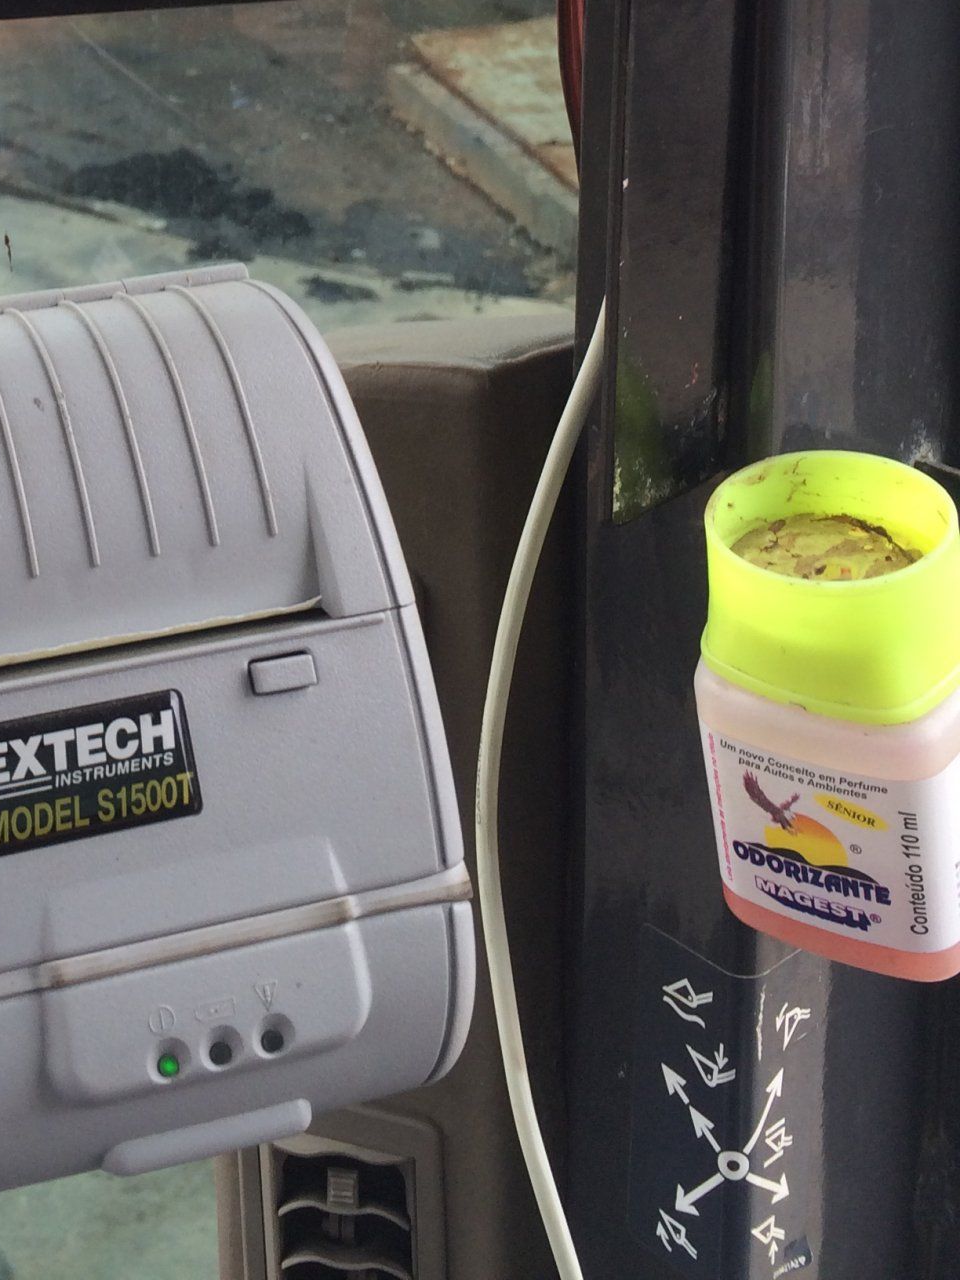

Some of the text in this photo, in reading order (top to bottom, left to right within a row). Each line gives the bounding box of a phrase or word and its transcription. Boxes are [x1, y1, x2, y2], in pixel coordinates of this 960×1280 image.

[54, 751, 175, 789] INSTRUMENTS
[719, 738, 889, 795] Um novo Conceito em Perfume
[738, 757, 868, 800] para Autos e Ambientes
[96, 771, 195, 823] S1500T
[732, 840, 892, 906] ODORIZANTE
[901, 835, 921, 861] 110
[754, 874, 871, 930] MAGEST
[904, 865, 929, 936] Conteúdo
